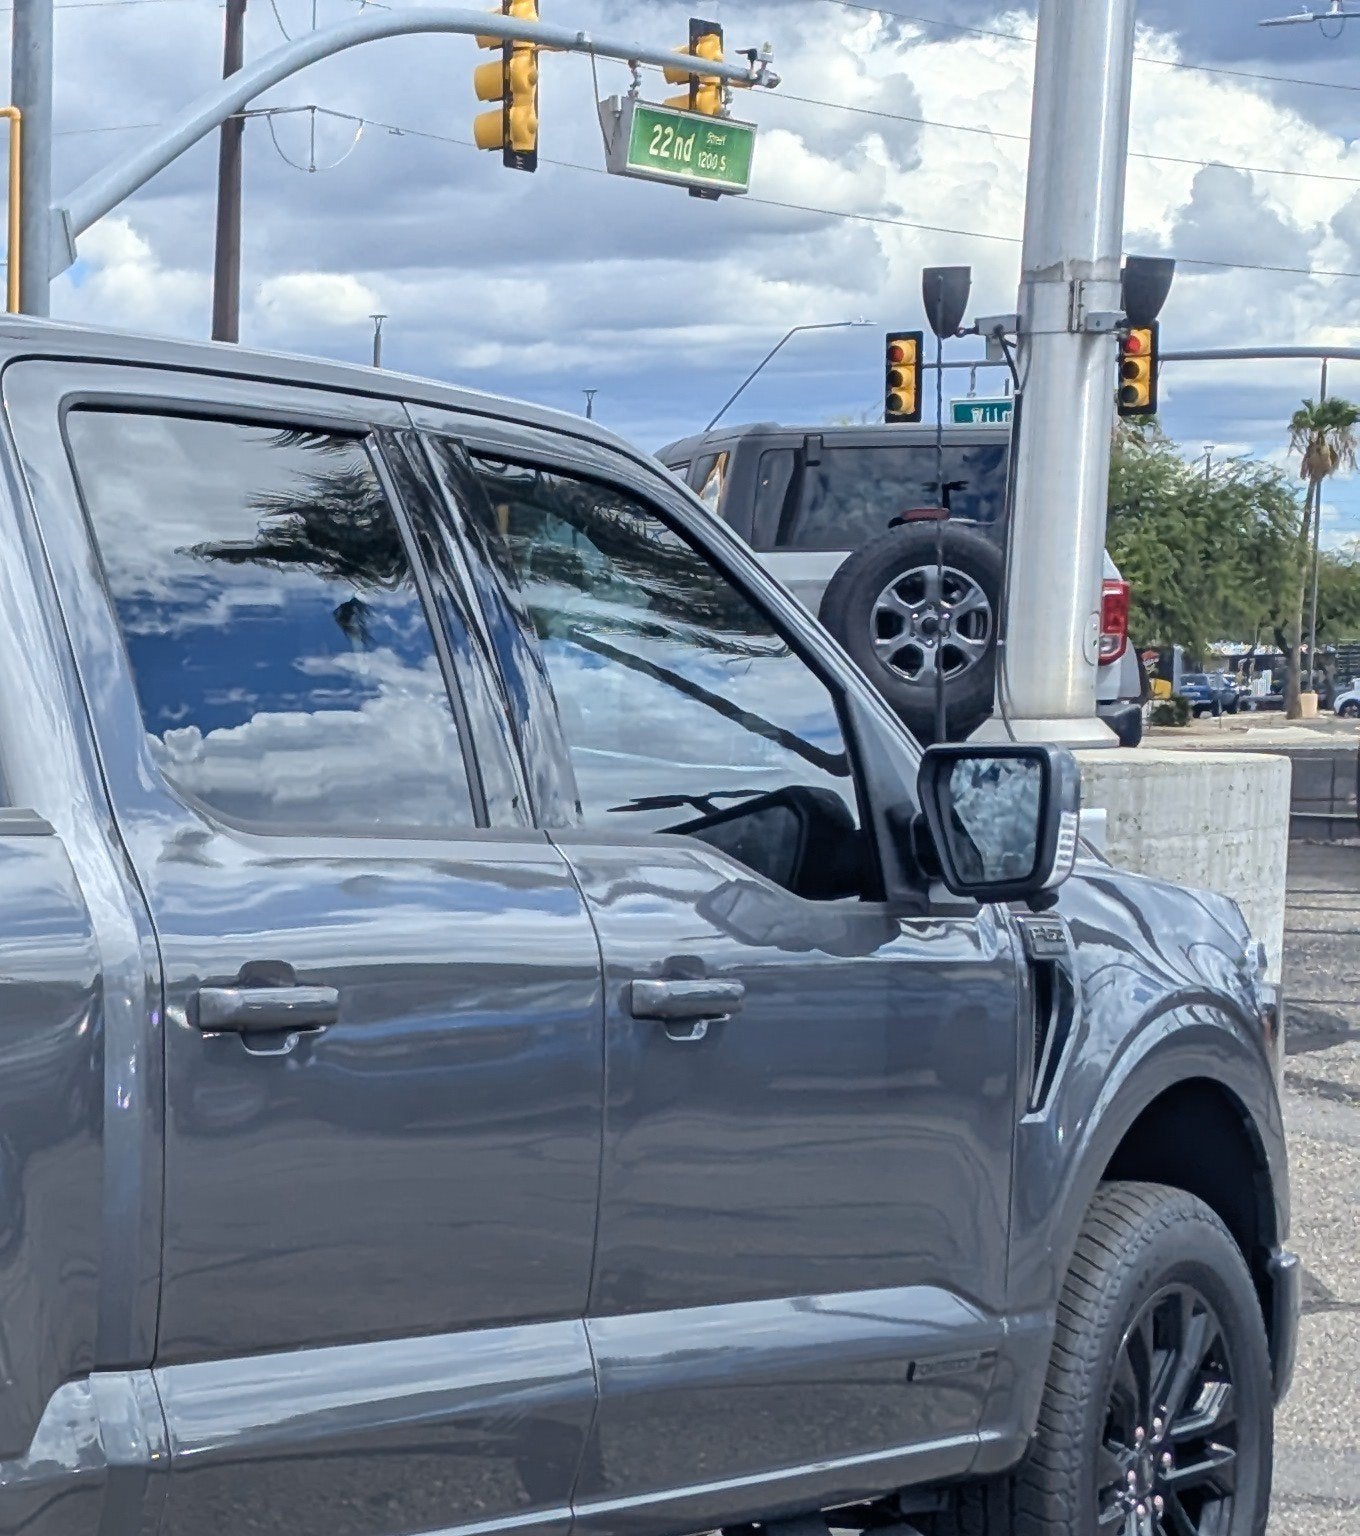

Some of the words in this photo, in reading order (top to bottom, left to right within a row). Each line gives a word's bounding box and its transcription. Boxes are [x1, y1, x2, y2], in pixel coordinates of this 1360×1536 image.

[649, 124, 696, 162] 22nd
[697, 151, 719, 170] 1200
[719, 155, 727, 171] S
